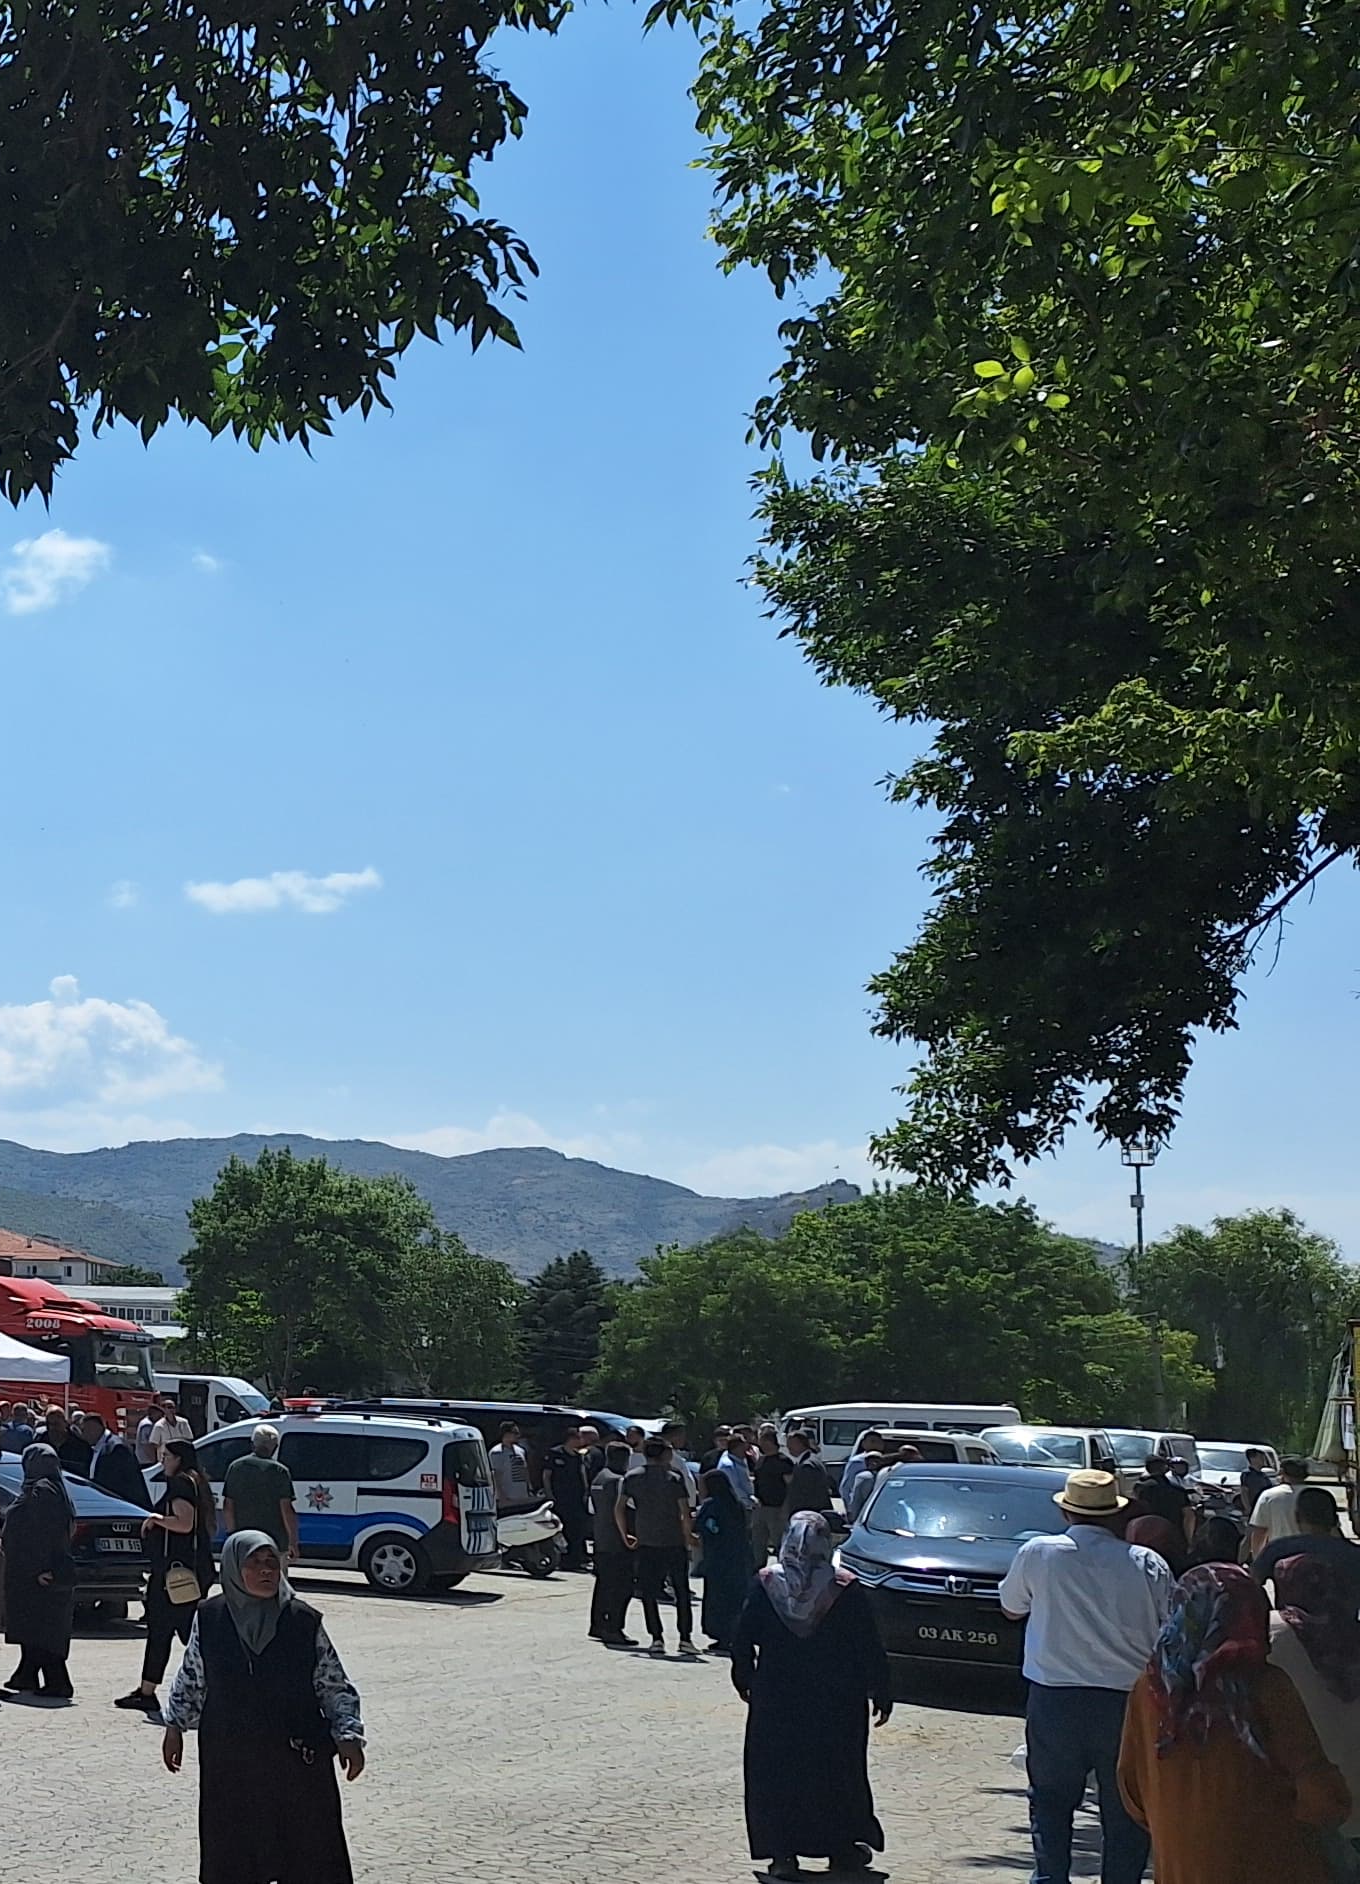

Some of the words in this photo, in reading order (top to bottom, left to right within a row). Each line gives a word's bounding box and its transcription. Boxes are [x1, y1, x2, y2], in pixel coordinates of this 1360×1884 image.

[26, 1318, 61, 1329] 2008
[918, 1627, 938, 1639] 03
[940, 1629, 964, 1642] AK
[967, 1631, 998, 1645] 256
